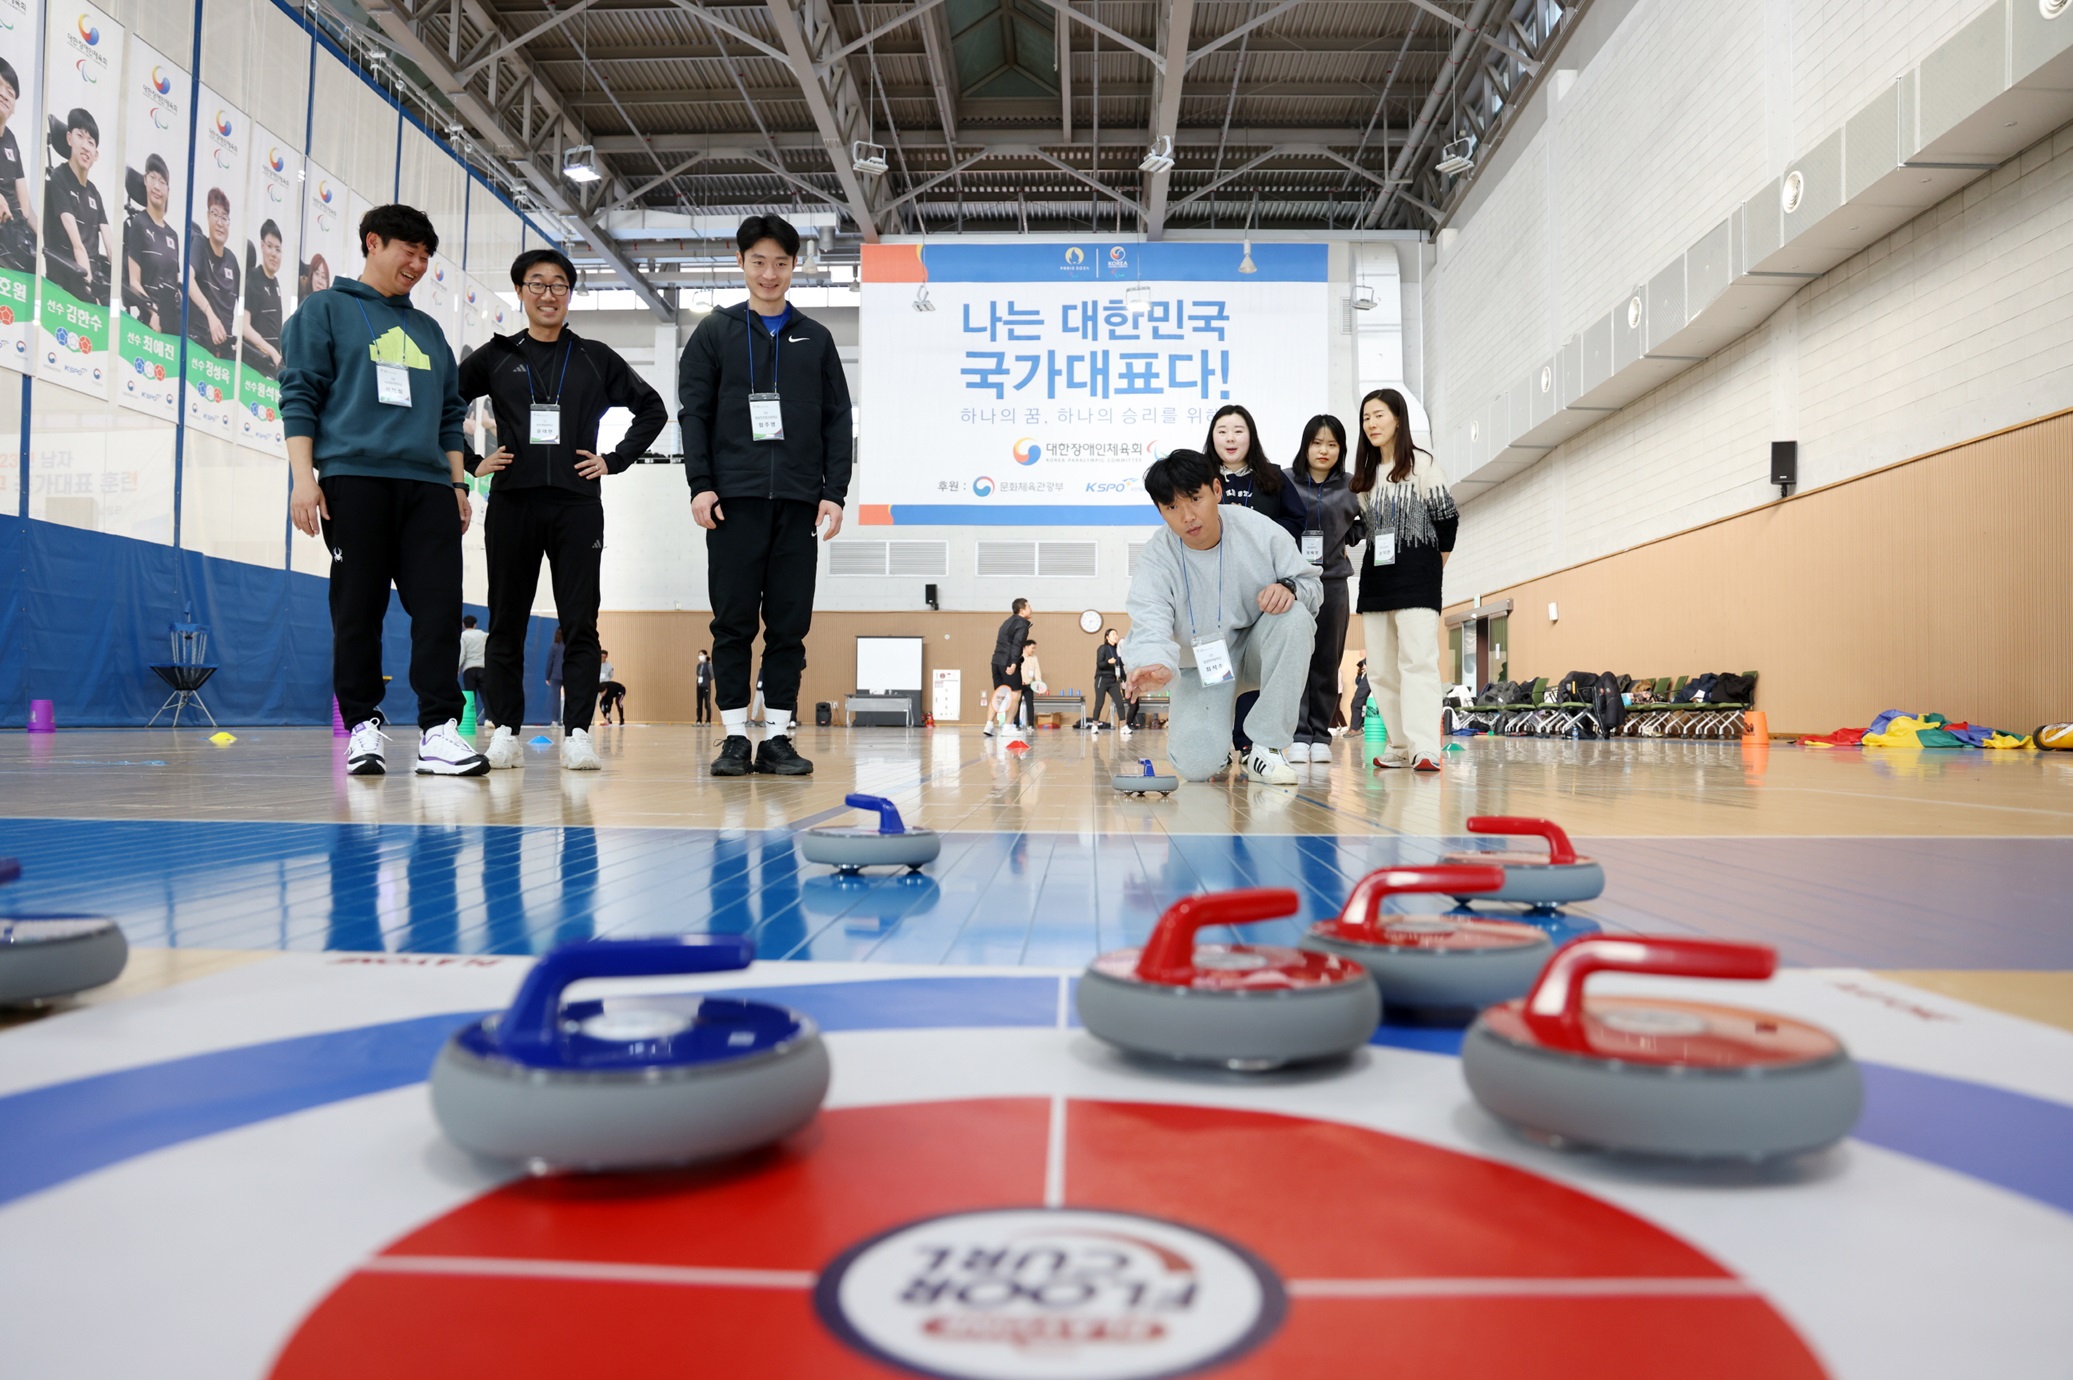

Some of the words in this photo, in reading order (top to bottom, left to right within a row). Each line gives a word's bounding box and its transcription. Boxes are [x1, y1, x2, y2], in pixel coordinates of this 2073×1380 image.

[47, 299, 65, 315] 선수
[66, 304, 103, 332] 김한수
[962, 300, 1045, 342] 나는
[1061, 299, 1230, 341] 대한민국
[127, 332, 141, 347] 선수
[143, 335, 175, 361] 최예진
[64, 364, 82, 376] KSPO
[191, 357, 205, 372] 선수
[960, 349, 1231, 400] 국가대표다!
[960, 407, 1017, 425] 하나의
[1058, 407, 1113, 425] 하나의
[1122, 407, 1178, 425] 승리를
[1046, 442, 1143, 457] 대한장애인체육회
[937, 480, 959, 493] 후원
[1000, 481, 1064, 493] 문화체육관광부
[1086, 482, 1125, 493] KSPO
[914, 1245, 1131, 1277] CURL
[899, 1275, 1199, 1311] FLOOR
